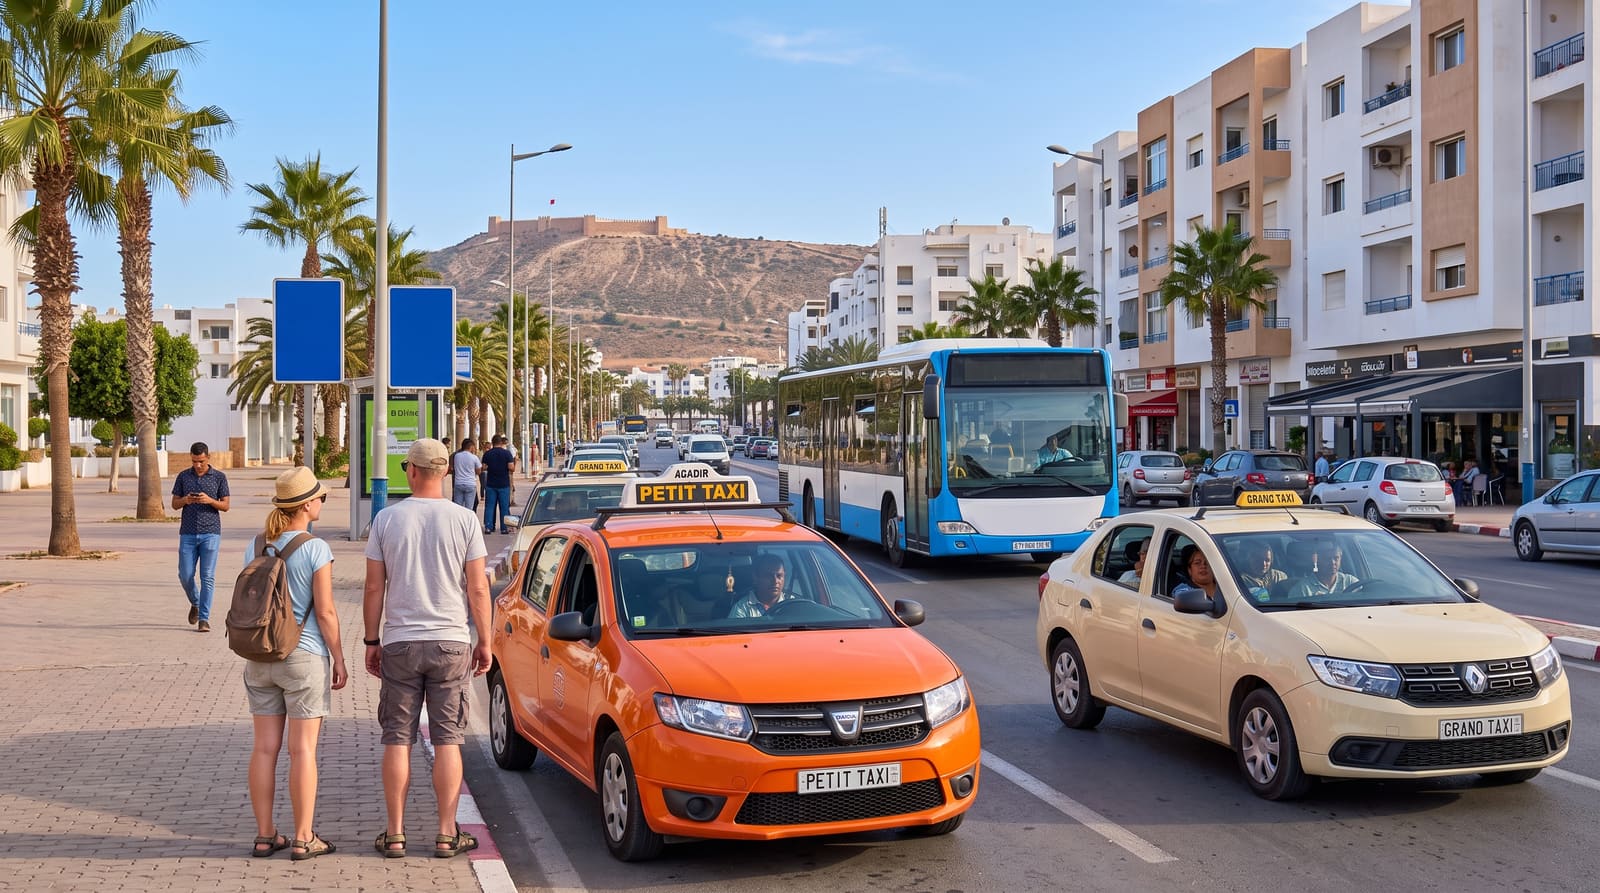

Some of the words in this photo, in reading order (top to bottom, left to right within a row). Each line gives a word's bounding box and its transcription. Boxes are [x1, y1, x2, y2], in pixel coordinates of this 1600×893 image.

[674, 469, 709, 479] AGADIR
[640, 484, 696, 502] PETIT
[702, 483, 745, 500] TAXI
[1275, 493, 1295, 503] TAXI
[1487, 718, 1513, 735] TAXI
[806, 770, 852, 791] PETIT
[857, 767, 889, 787] TAXI
